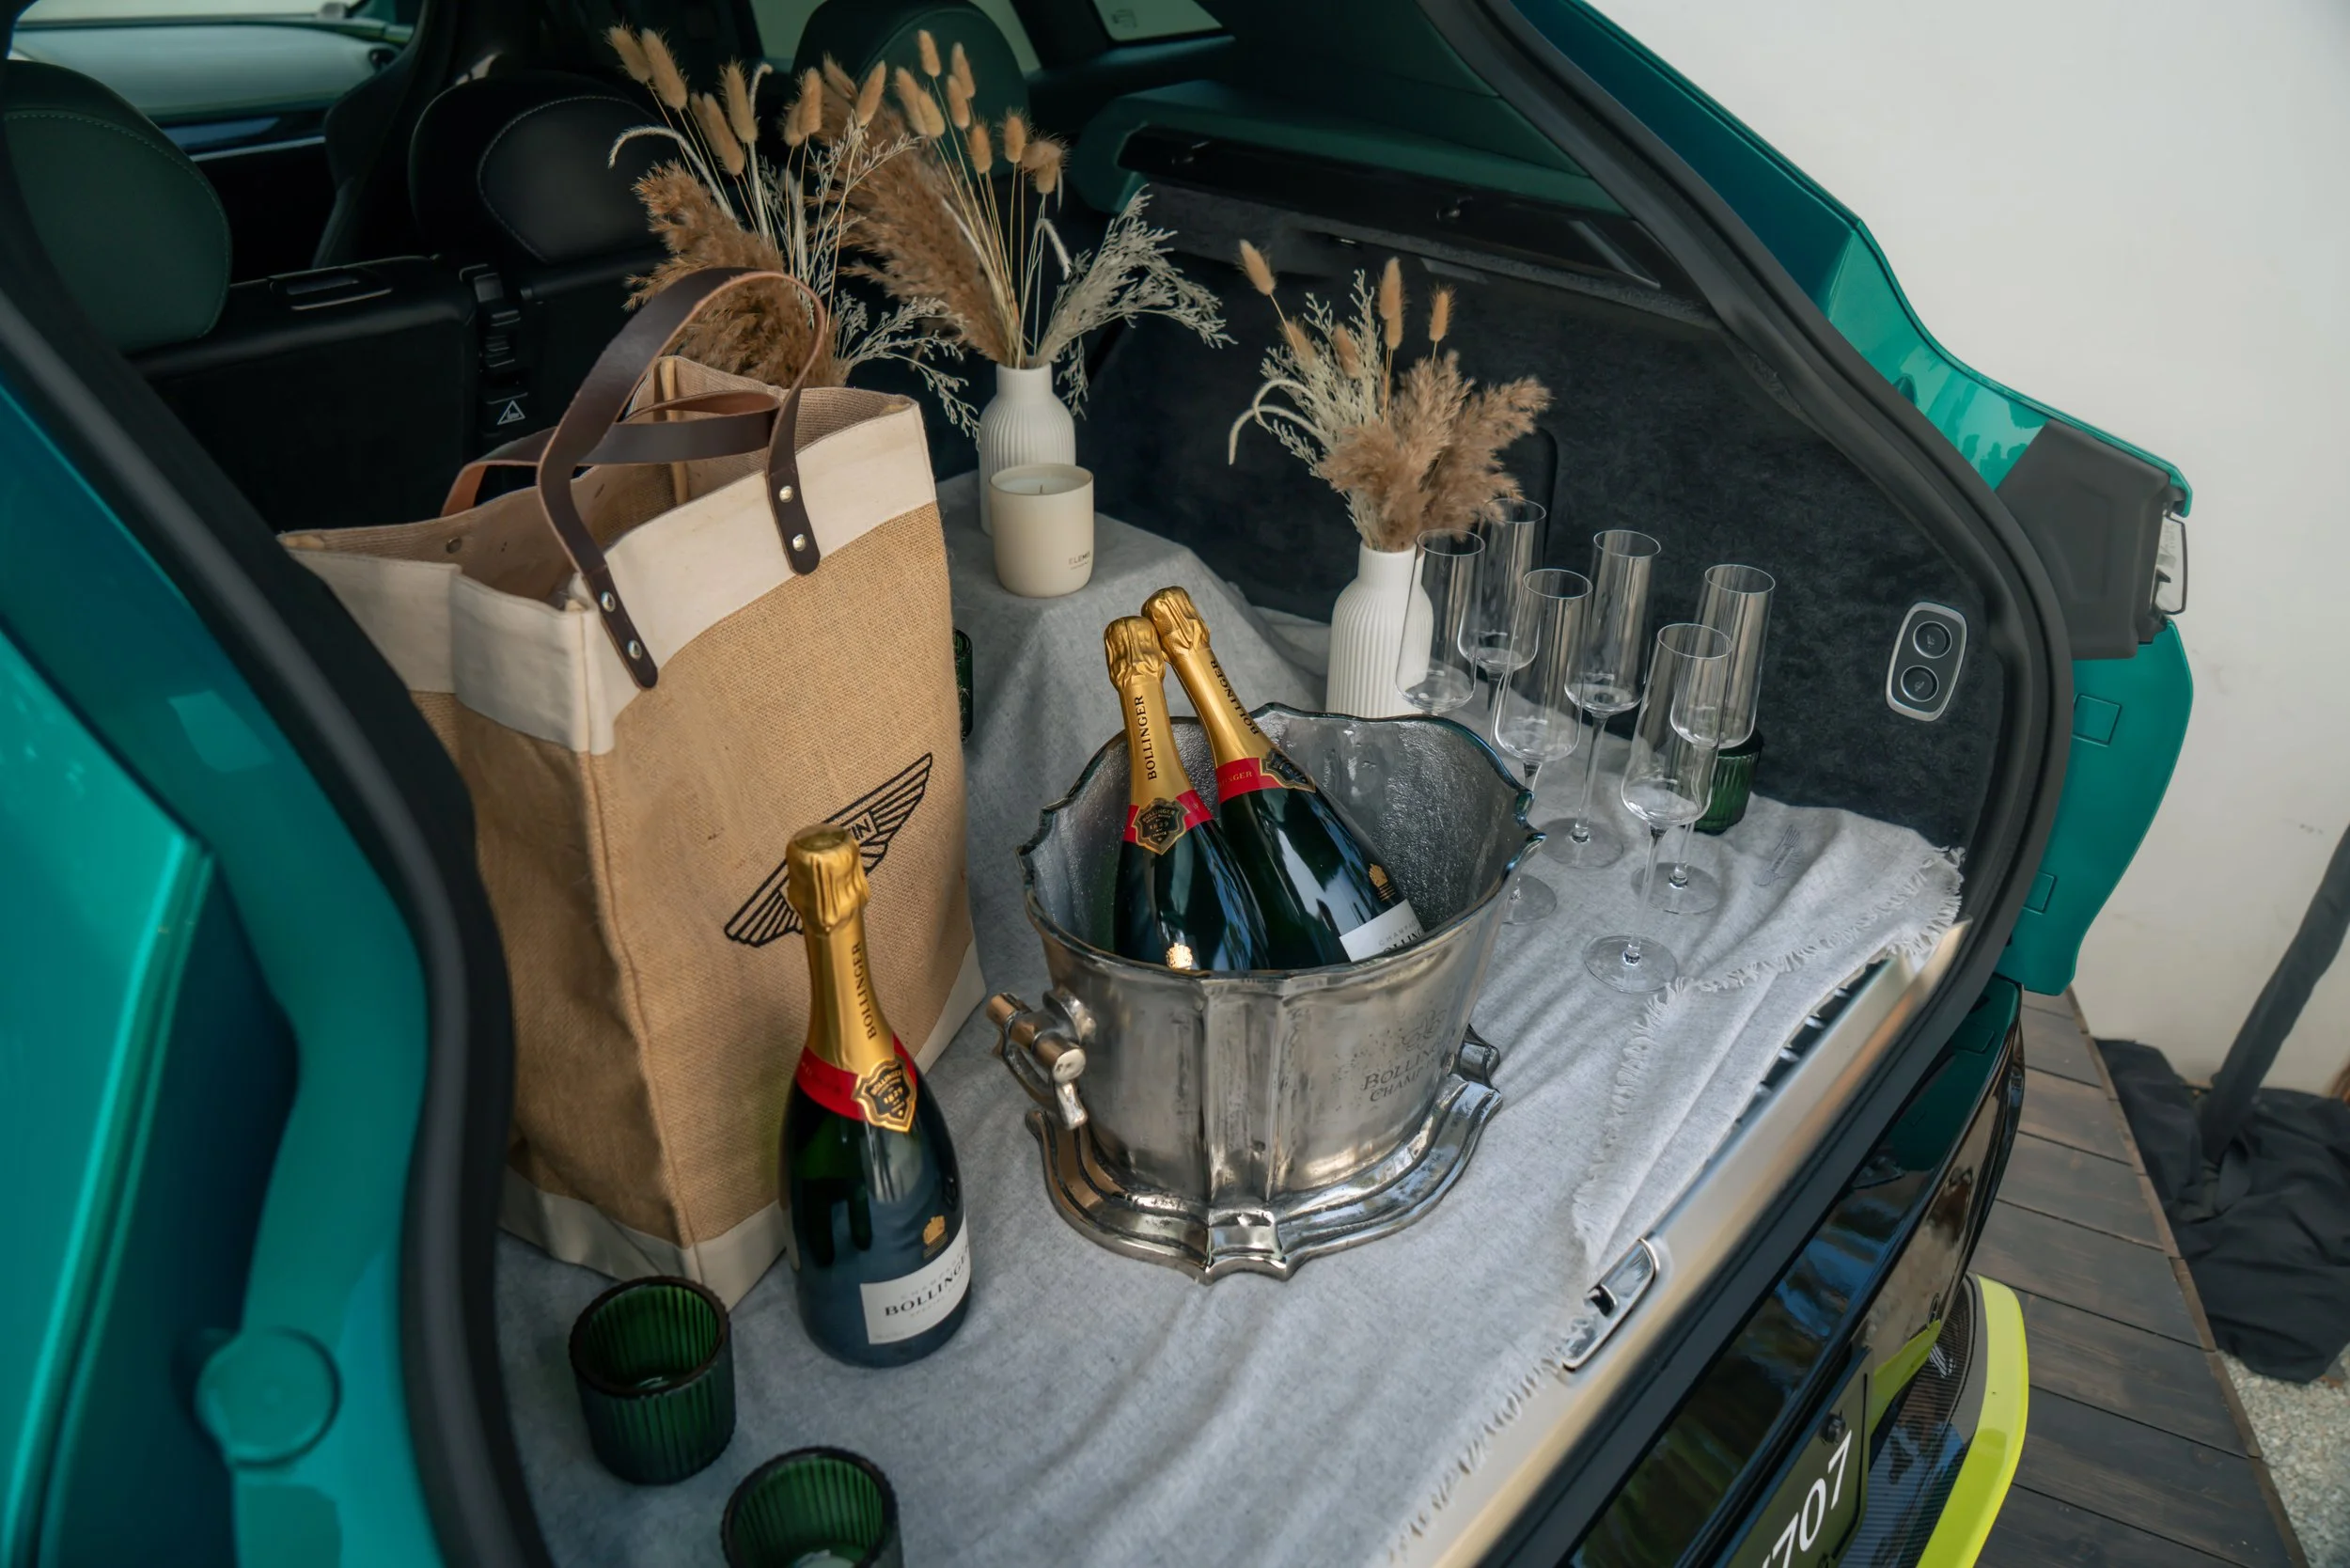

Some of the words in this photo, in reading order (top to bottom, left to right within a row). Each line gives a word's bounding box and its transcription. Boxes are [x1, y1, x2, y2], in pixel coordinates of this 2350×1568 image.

[1134, 696, 1157, 780] BOLLINGER
[1211, 660, 1259, 736] BOLLINGER
[852, 941, 877, 1041] BOLLINGER
